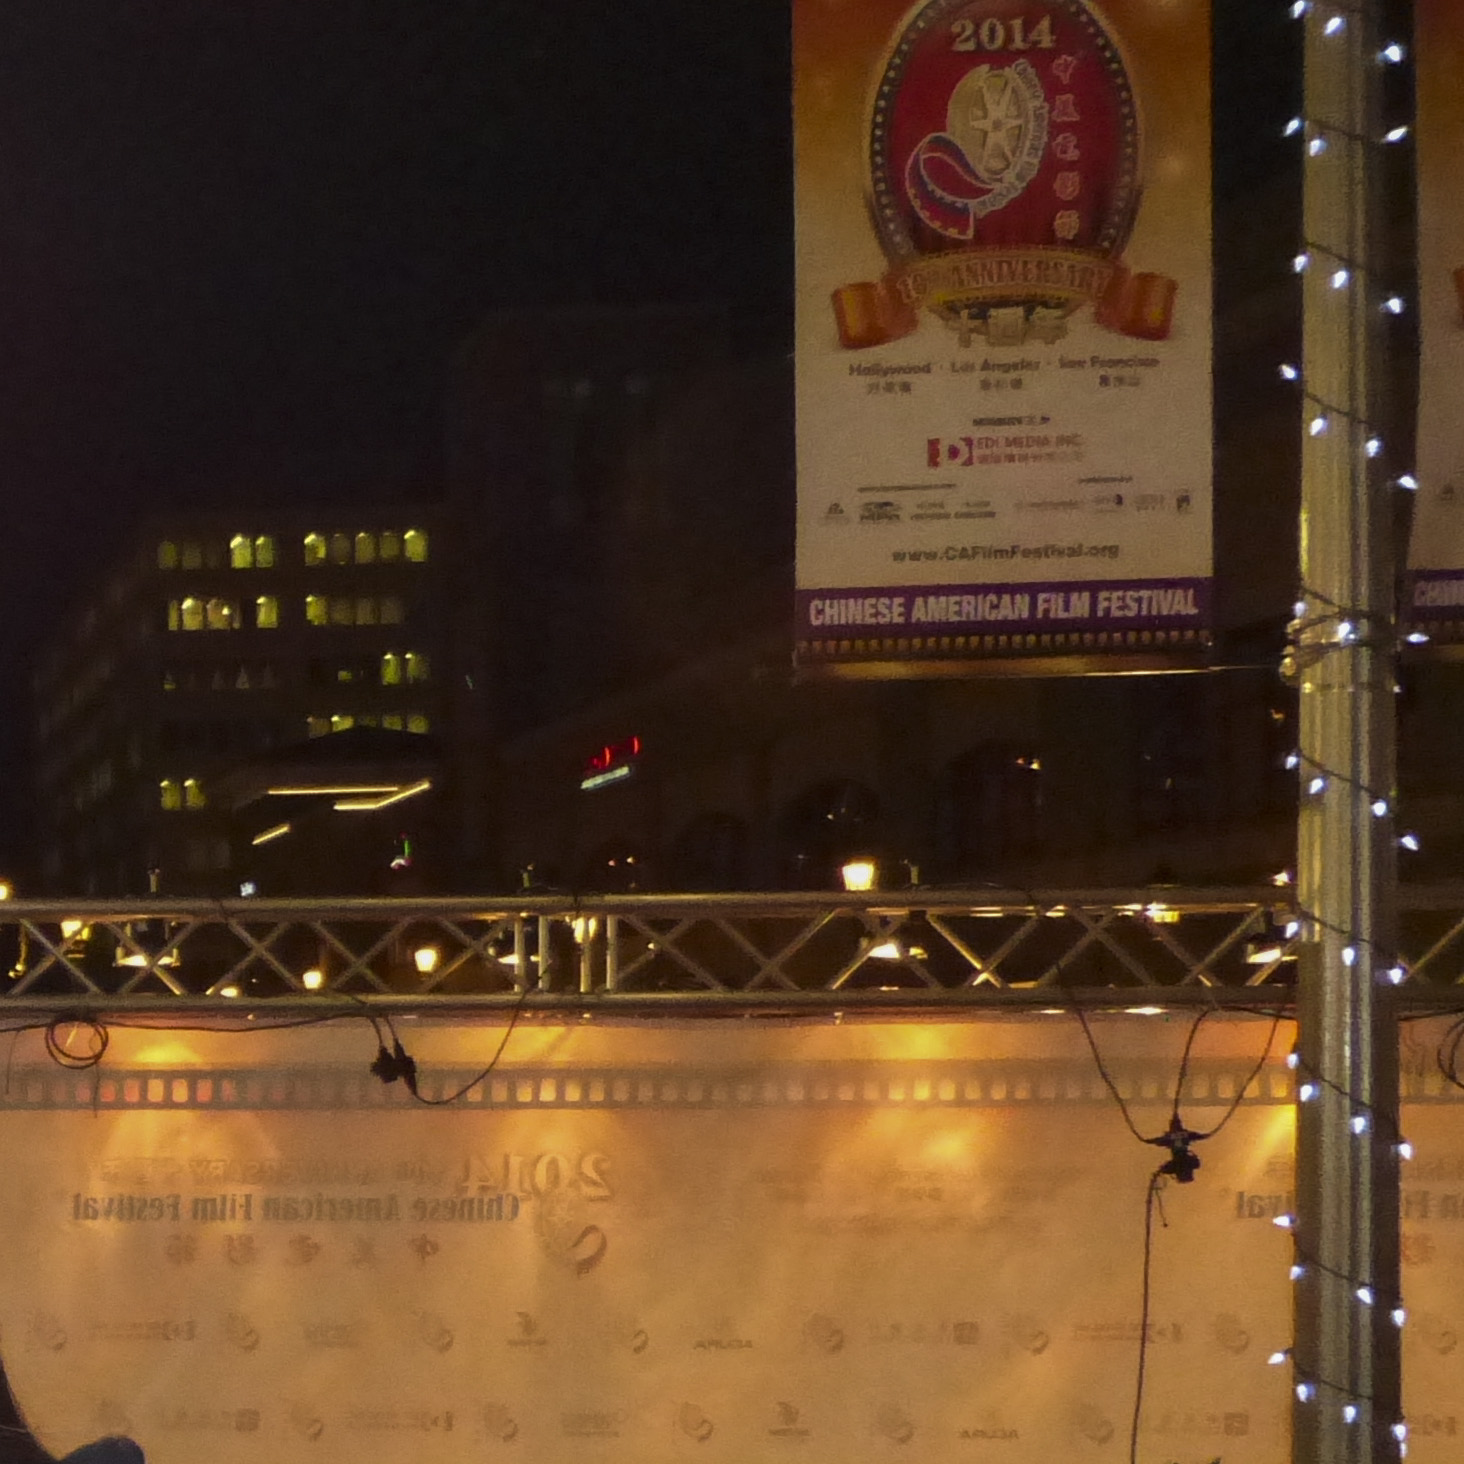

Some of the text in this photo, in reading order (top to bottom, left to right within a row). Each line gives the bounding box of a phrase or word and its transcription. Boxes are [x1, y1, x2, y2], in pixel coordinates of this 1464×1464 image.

[952, 15, 1056, 52] 2014
[849, 361, 932, 377] Hollywood
[950, 360, 976, 374] Los
[979, 357, 1041, 374] Angeles
[1090, 353, 1160, 369] Francisco
[891, 543, 1120, 562] www.CAFilmFestival.org
[809, 587, 1200, 626] CHINESE AMERICAN FILM FESTIVAL
